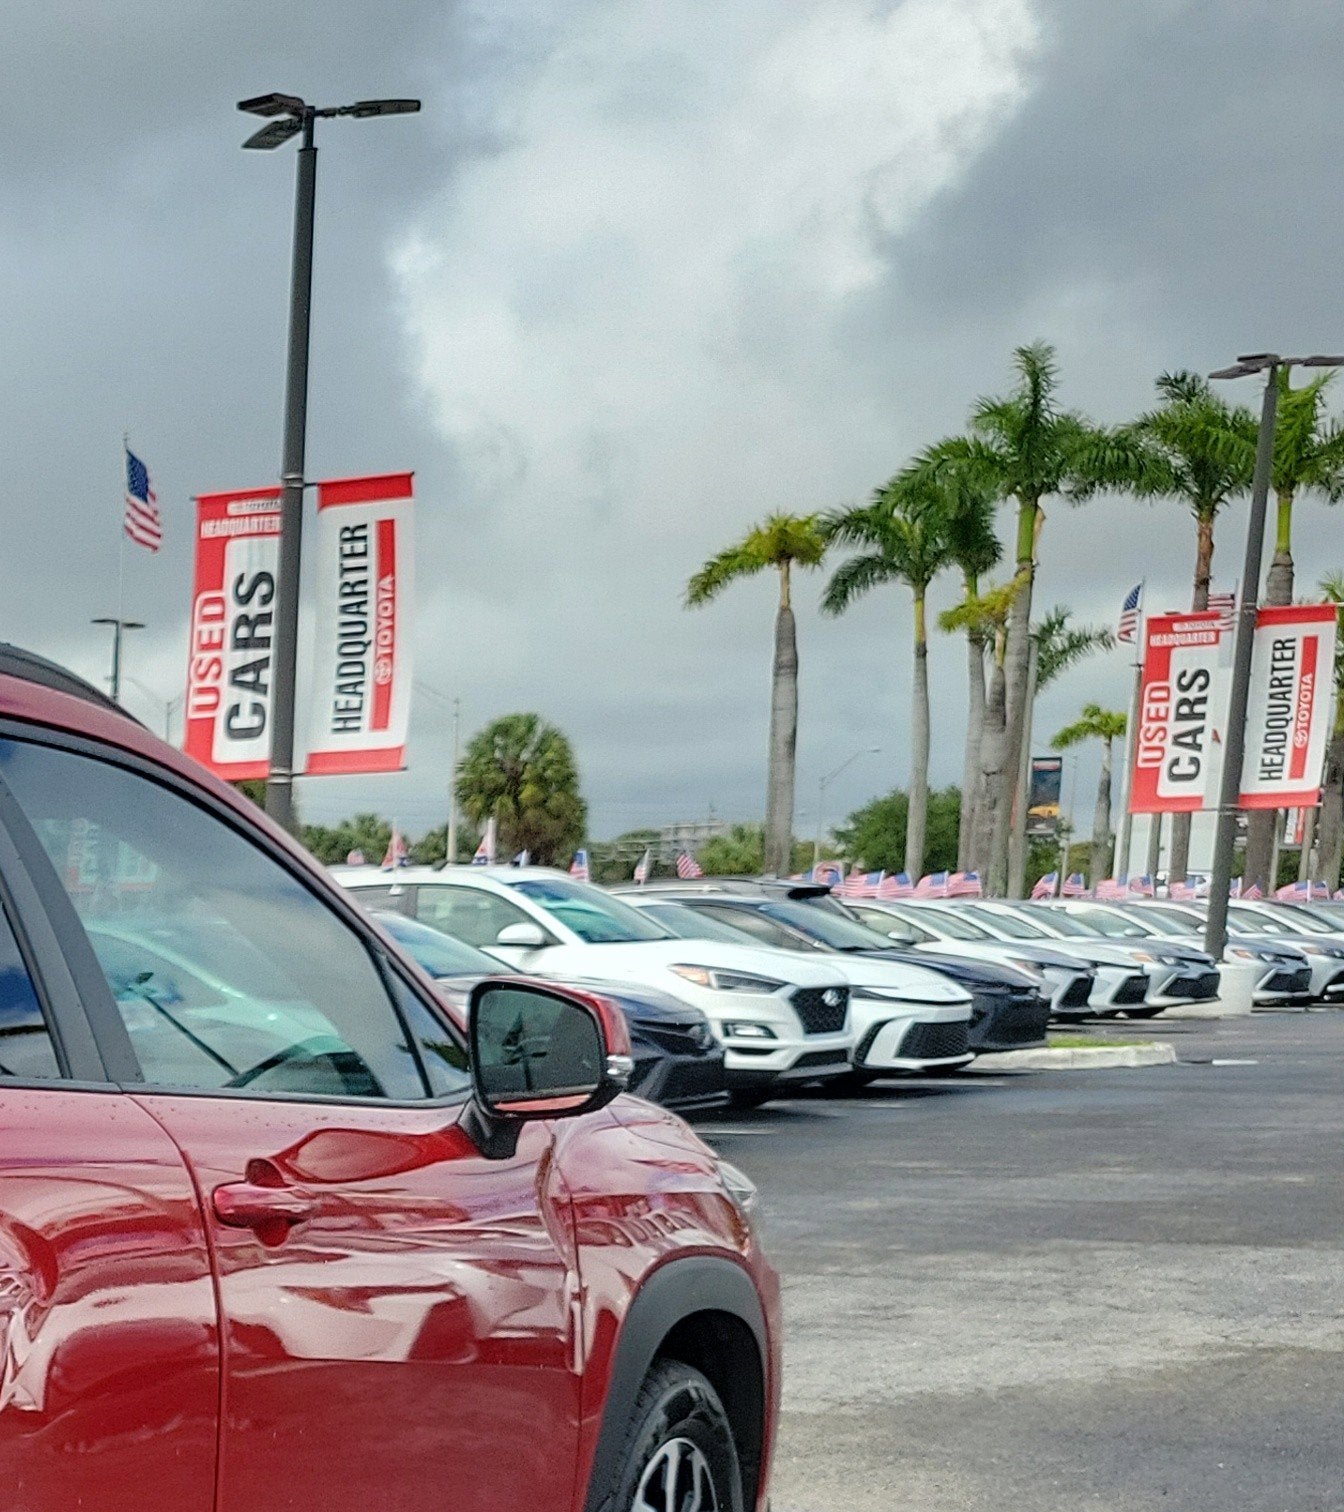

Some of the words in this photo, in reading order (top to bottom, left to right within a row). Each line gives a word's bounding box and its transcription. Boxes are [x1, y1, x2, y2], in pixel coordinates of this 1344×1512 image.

[189, 592, 226, 718] USED
[225, 571, 275, 741] CARS
[331, 522, 371, 734] HEADQUARTER
[376, 572, 395, 657] TOYOTA
[1138, 682, 1171, 768] USED
[1167, 668, 1210, 782] CARS
[1258, 637, 1297, 781] HEADQUARTER
[1297, 673, 1314, 733] TOYOTA
